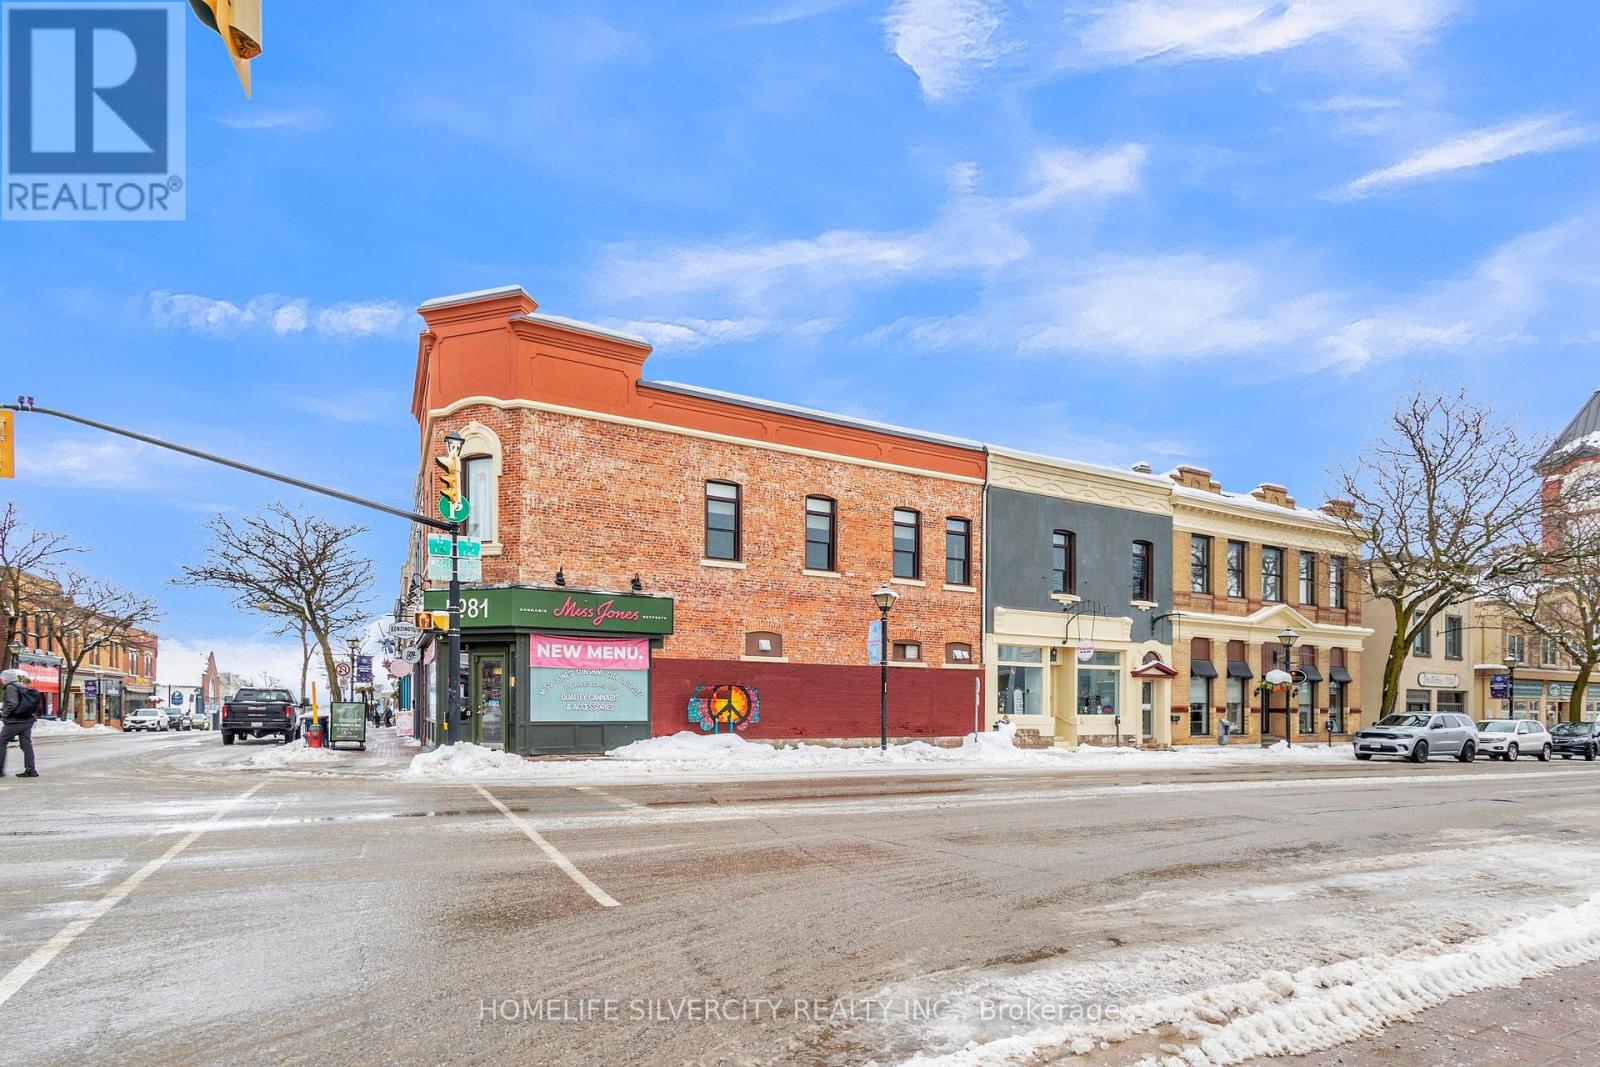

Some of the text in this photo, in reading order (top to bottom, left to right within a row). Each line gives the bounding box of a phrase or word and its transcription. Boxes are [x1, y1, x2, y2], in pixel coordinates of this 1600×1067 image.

[592, 600, 639, 626] Jones
[537, 643, 644, 660] NEW MENU.
[561, 693, 619, 702] QUALITY CANNABIS
[573, 703, 615, 711] ACCESSORIES
